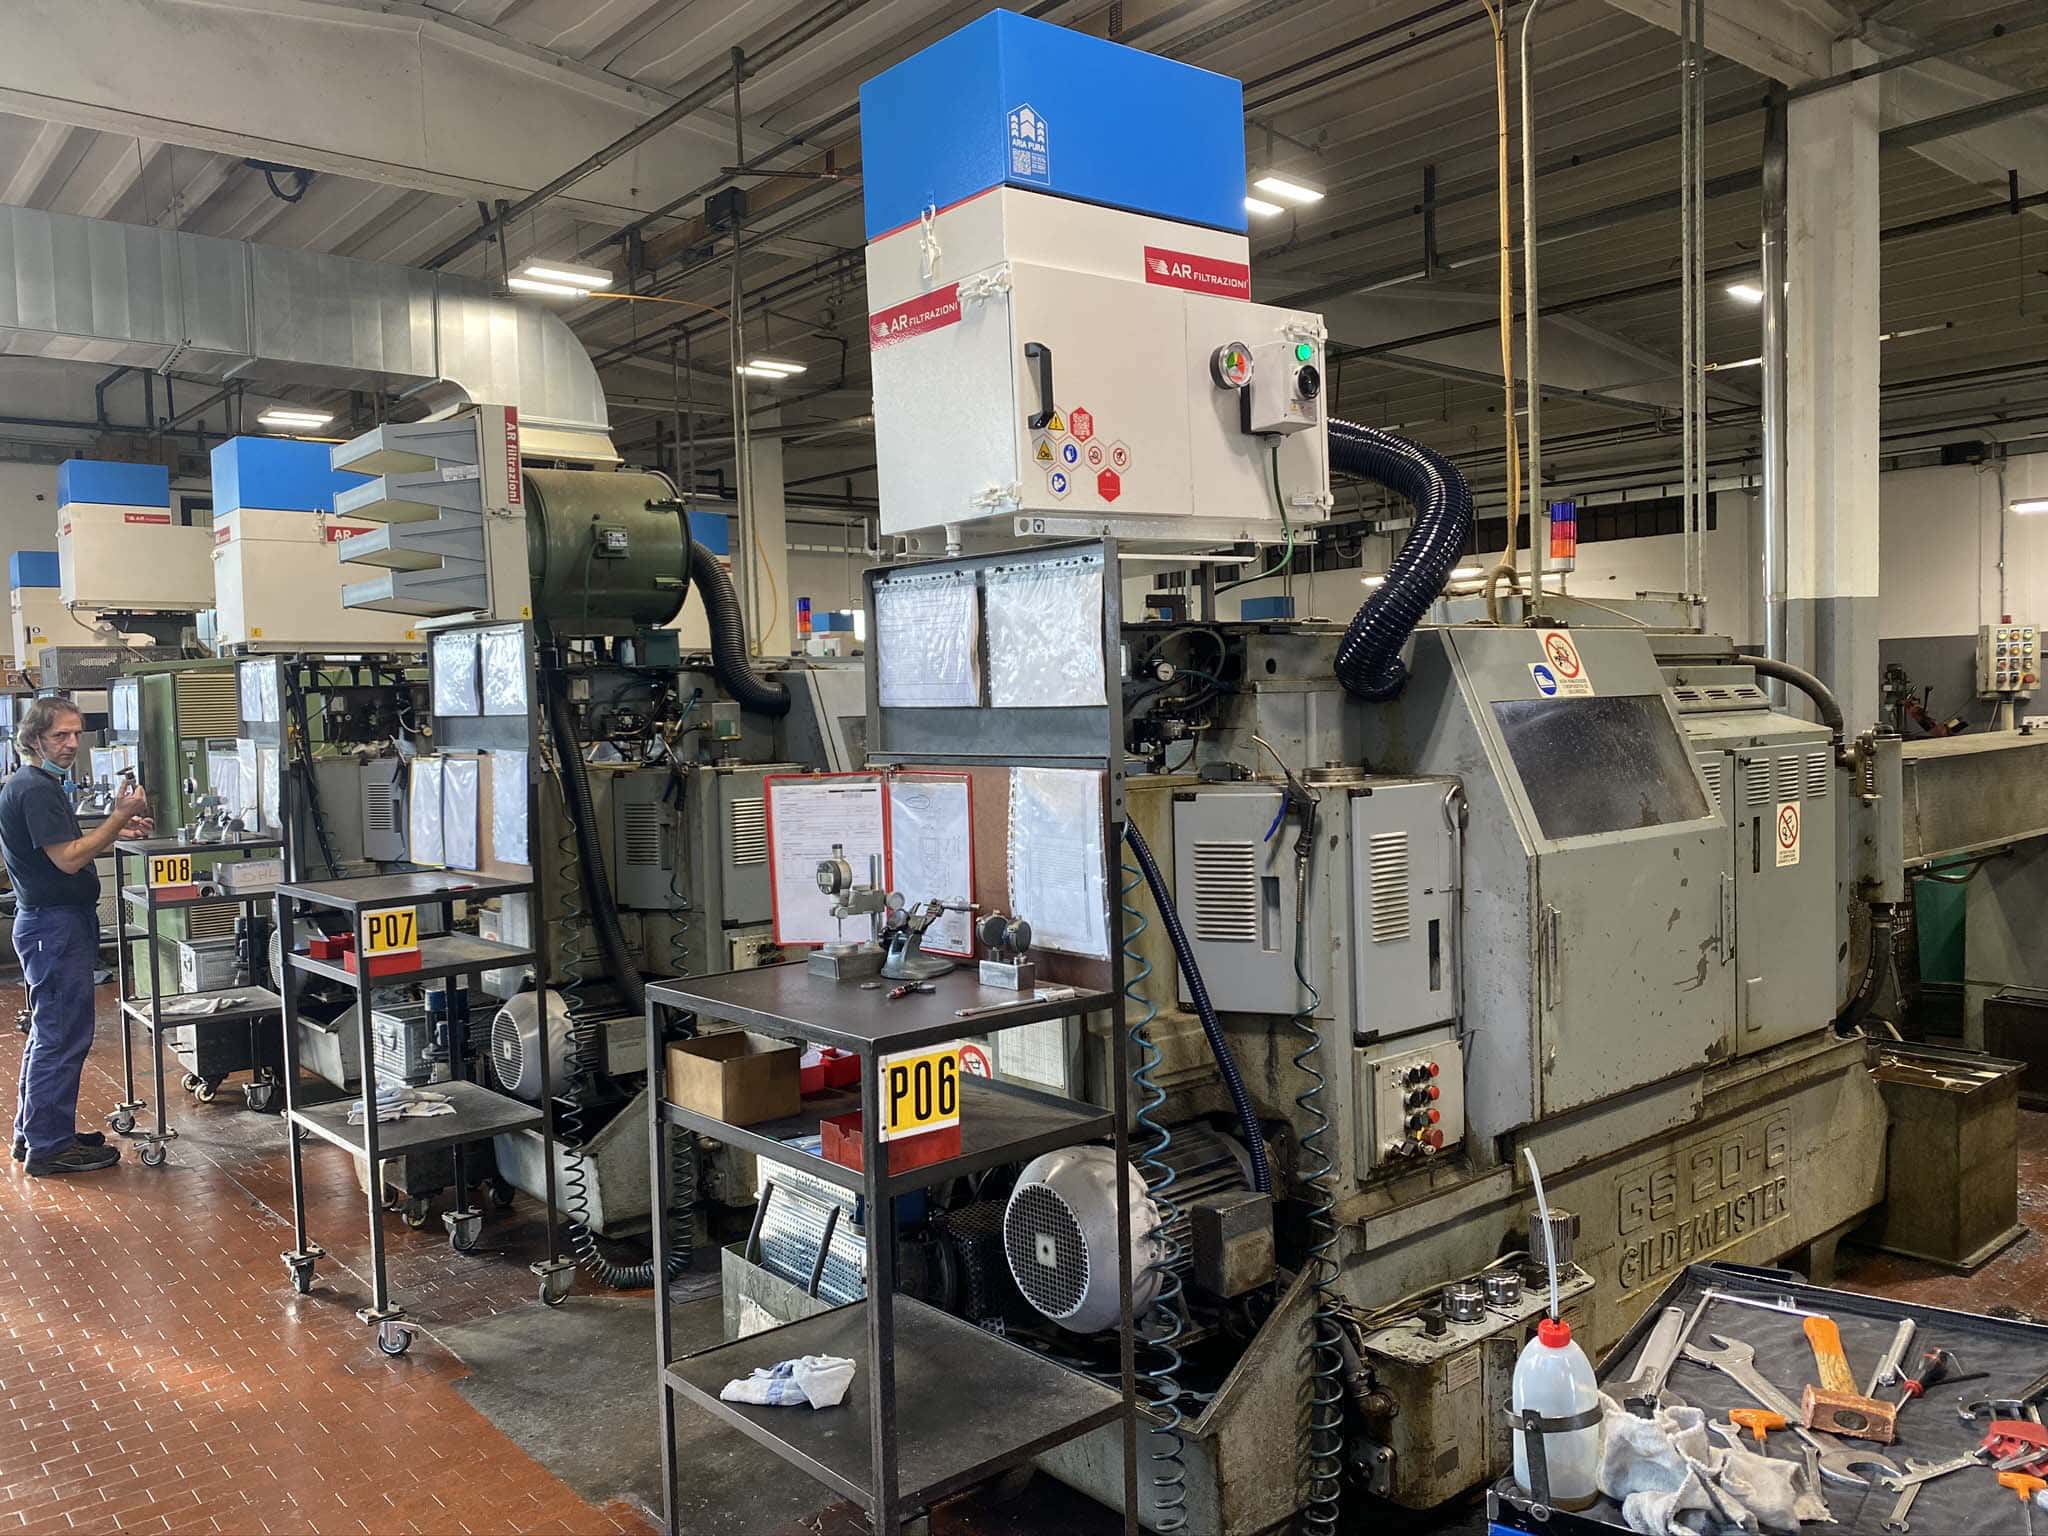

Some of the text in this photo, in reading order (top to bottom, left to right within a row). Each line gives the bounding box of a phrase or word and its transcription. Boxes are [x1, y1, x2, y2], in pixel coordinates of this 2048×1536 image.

[1012, 138, 1045, 153] ARIA PURA
[1171, 262, 1247, 288] AR FILTRAZIONI
[890, 302, 958, 333] AR FILTRAZIONI
[506, 422, 516, 440] AR
[334, 529, 352, 540] AR
[154, 858, 189, 883] P08
[368, 911, 413, 949] P07
[890, 1055, 956, 1127] P06
[1618, 1163, 1676, 1236] GS
[1618, 1175, 1788, 1289] GILDEMEISTER
